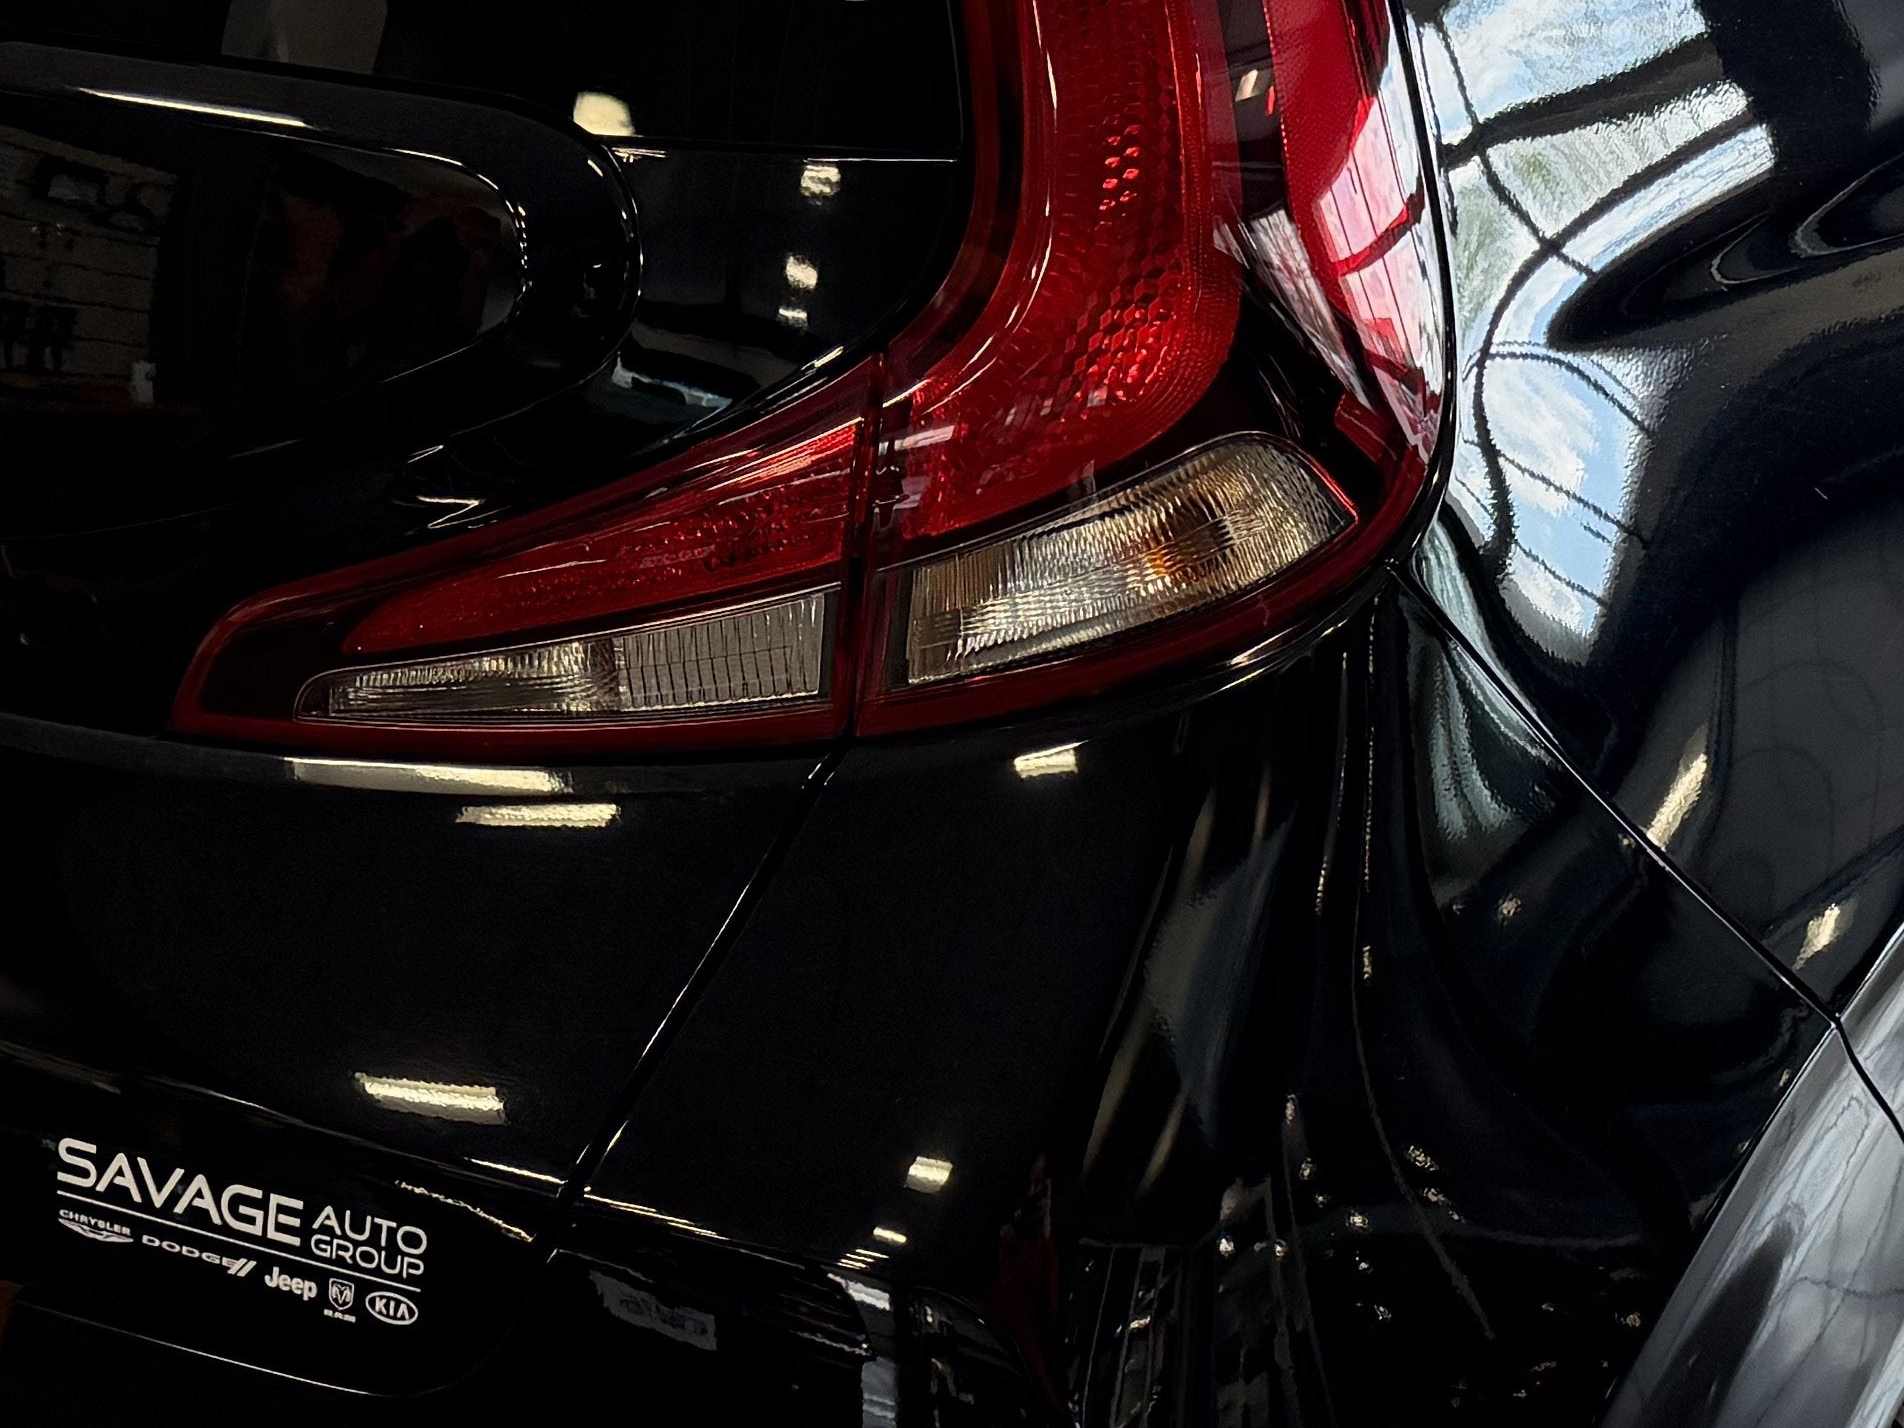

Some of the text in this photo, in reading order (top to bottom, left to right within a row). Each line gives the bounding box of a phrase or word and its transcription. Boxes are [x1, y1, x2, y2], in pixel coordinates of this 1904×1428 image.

[57, 1137, 304, 1247] SAVAGE
[59, 1209, 132, 1236] CHRYSLER
[311, 1205, 428, 1256] AUTO
[142, 1234, 240, 1271] DODGE
[310, 1234, 425, 1279] GROUP
[264, 1266, 318, 1301] Jeep
[374, 1296, 410, 1320] KIA
